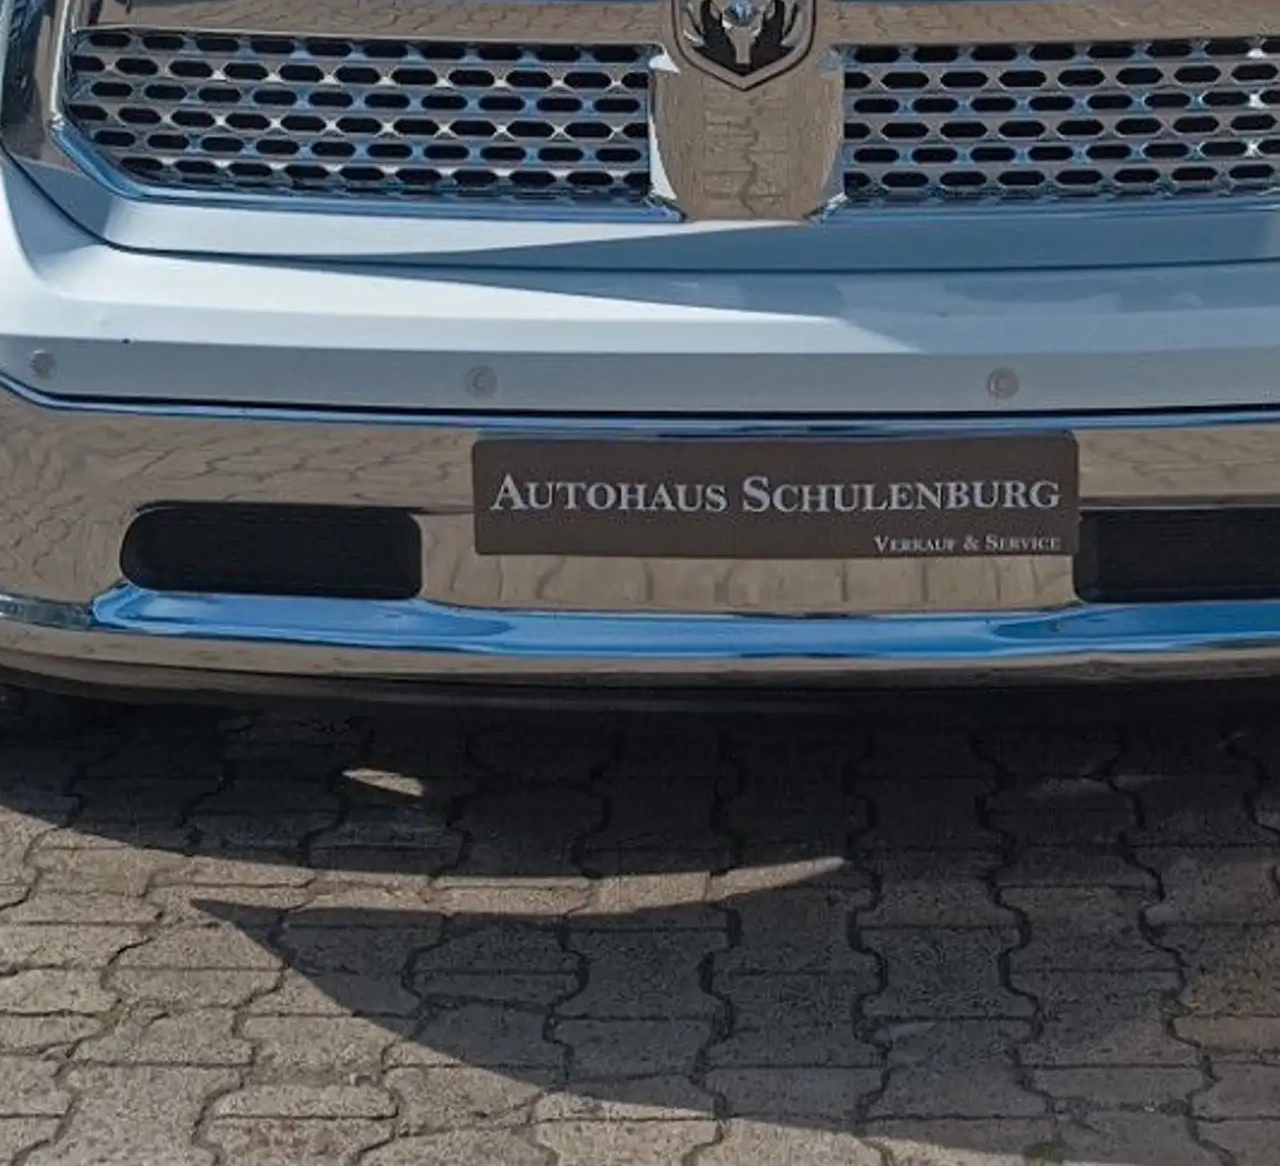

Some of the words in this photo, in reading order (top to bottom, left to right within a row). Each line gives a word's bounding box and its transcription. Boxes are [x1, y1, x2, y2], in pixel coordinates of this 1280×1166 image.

[490, 474, 727, 512] AUTOHAUS
[742, 474, 1061, 512] SCHULENBURG
[873, 534, 957, 554] VERKAUF
[963, 535, 980, 552] &
[984, 532, 1061, 553] SERVICE
